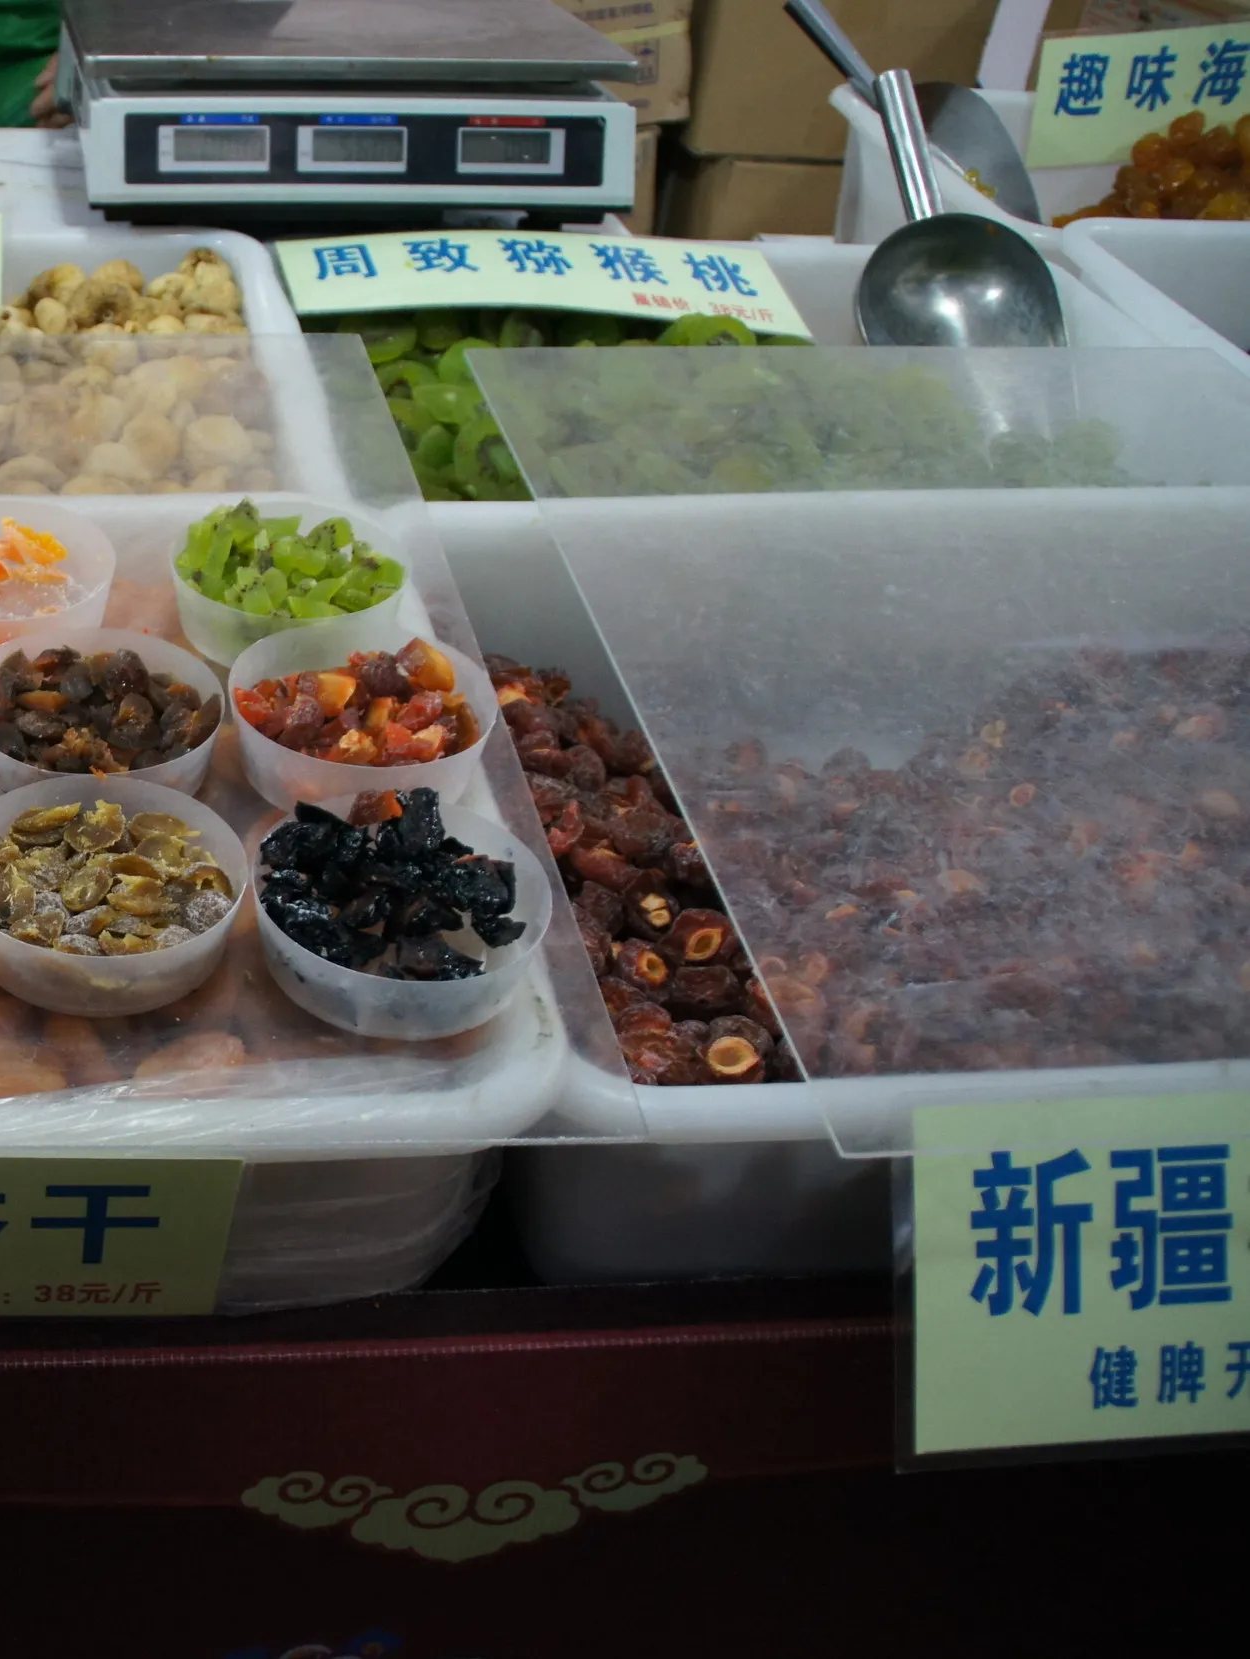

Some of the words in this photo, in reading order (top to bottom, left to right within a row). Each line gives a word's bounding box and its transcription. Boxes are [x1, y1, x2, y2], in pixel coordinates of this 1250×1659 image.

[1054, 39, 1250, 116] 趣味海
[315, 236, 758, 298] 周致猕猴桃
